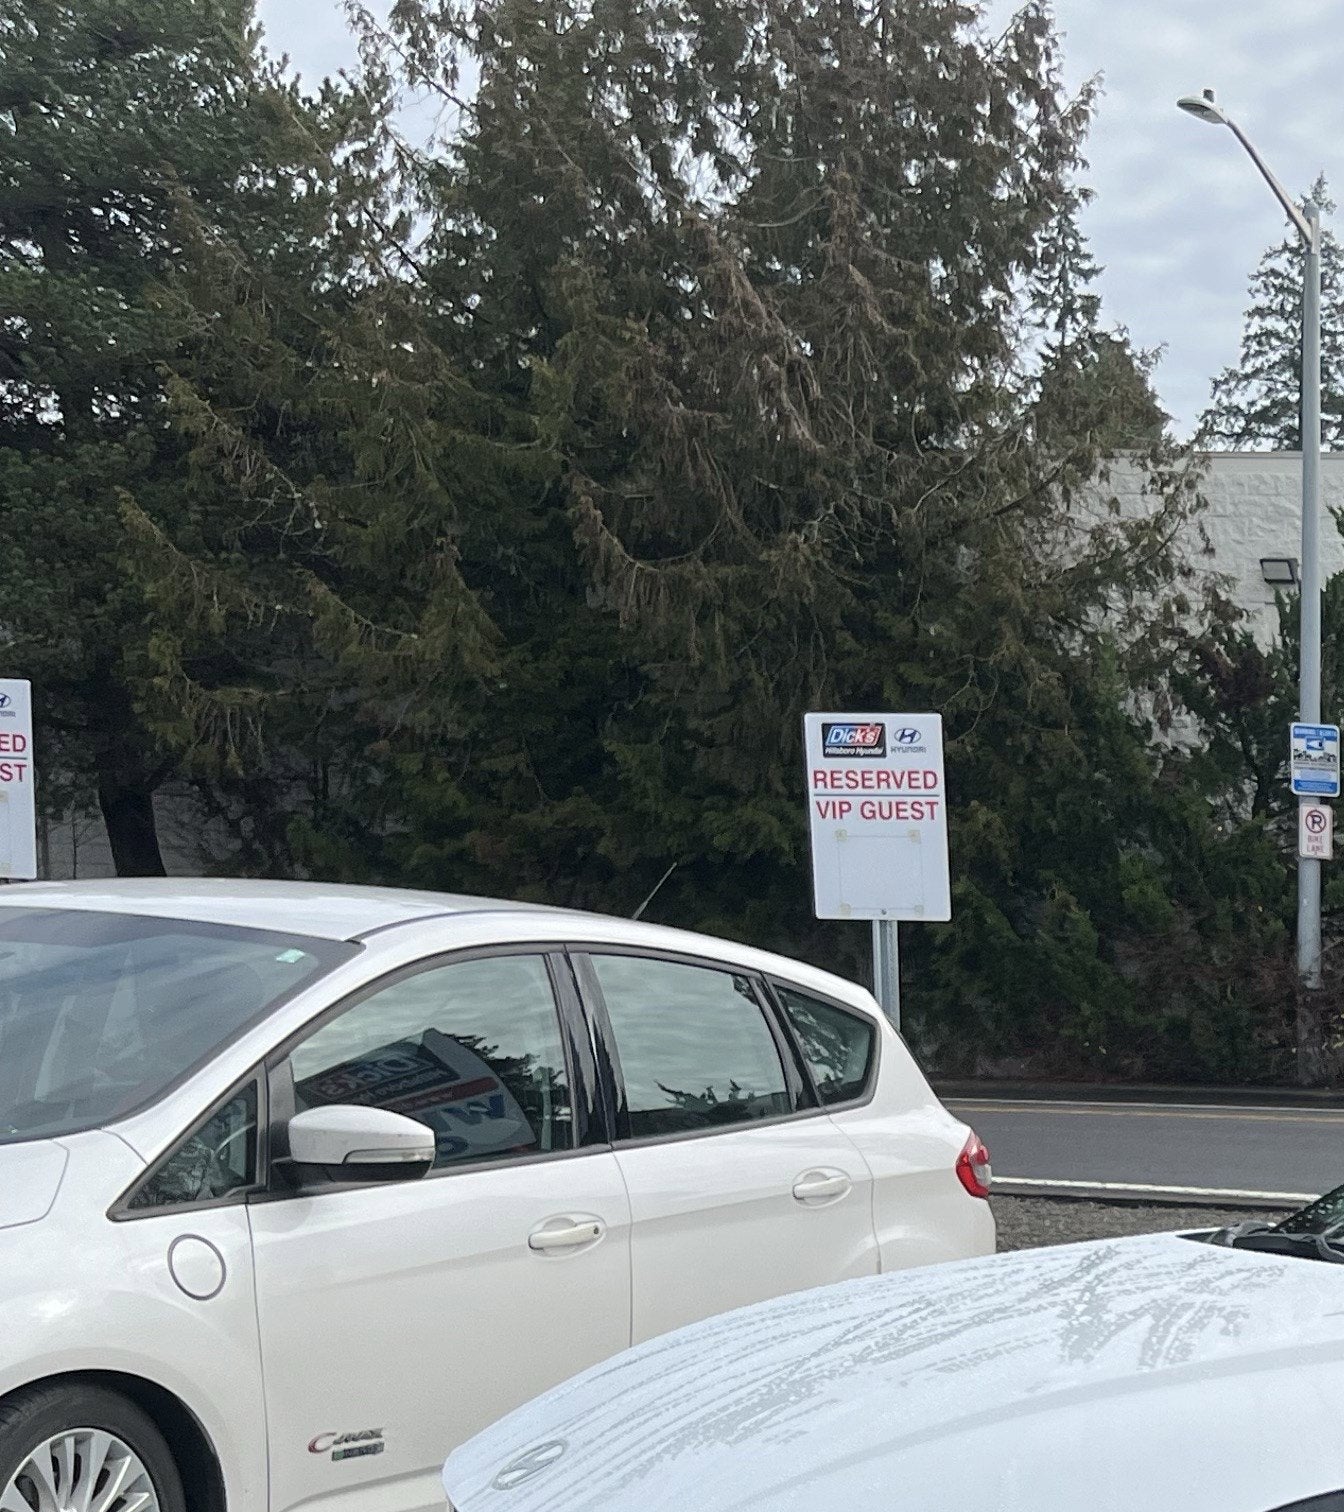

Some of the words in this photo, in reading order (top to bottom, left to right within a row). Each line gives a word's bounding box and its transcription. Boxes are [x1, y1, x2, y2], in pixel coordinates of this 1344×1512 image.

[813, 770, 938, 789] RESERVED
[816, 801, 852, 819] VIP
[860, 801, 939, 820] GUEST
